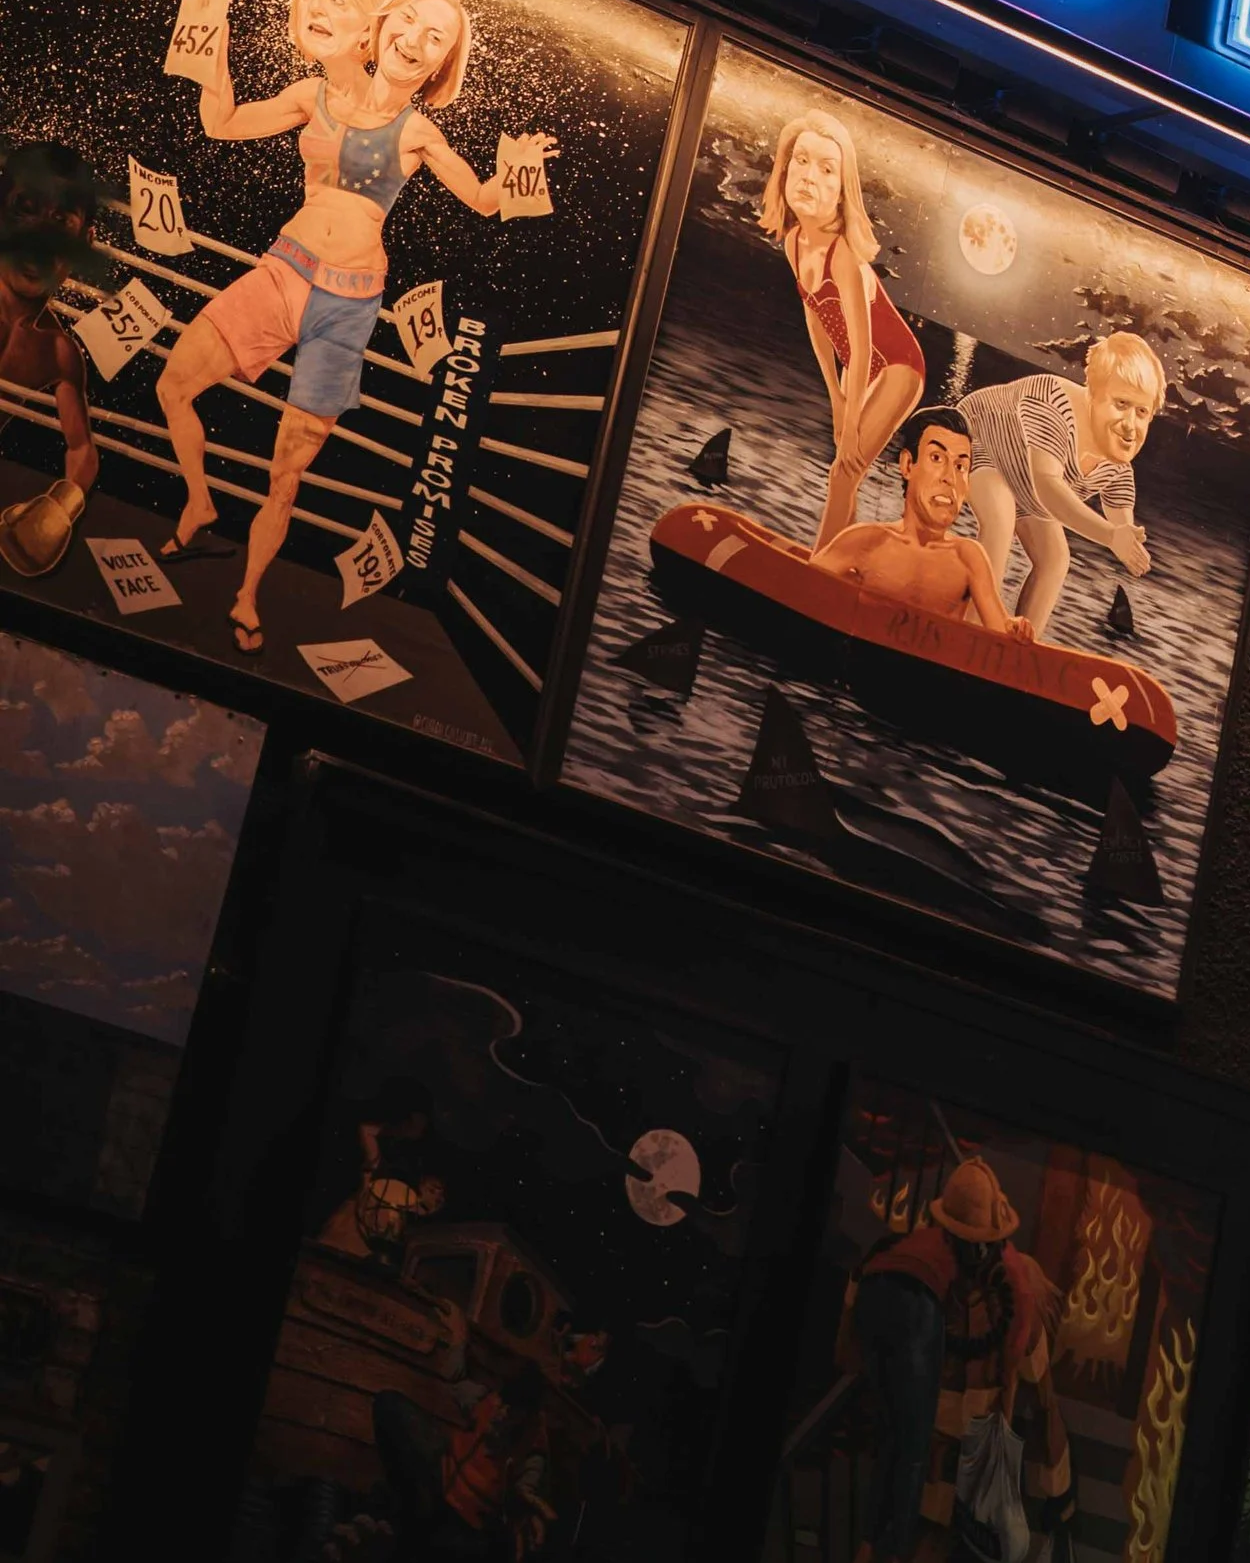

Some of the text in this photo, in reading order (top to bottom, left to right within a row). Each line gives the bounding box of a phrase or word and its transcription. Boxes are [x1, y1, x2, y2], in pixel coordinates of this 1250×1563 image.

[173, 24, 219, 57] 45%
[133, 163, 175, 188] INCOME
[502, 164, 546, 199] 40%
[125, 290, 160, 329] CORPORATE
[397, 285, 437, 313] INCOME
[101, 299, 144, 353] 25%
[406, 316, 487, 570] BROKEN PROMISES
[101, 552, 149, 571] VOLTE
[371, 522, 398, 578] CORPORATE
[114, 575, 162, 598] FACE
